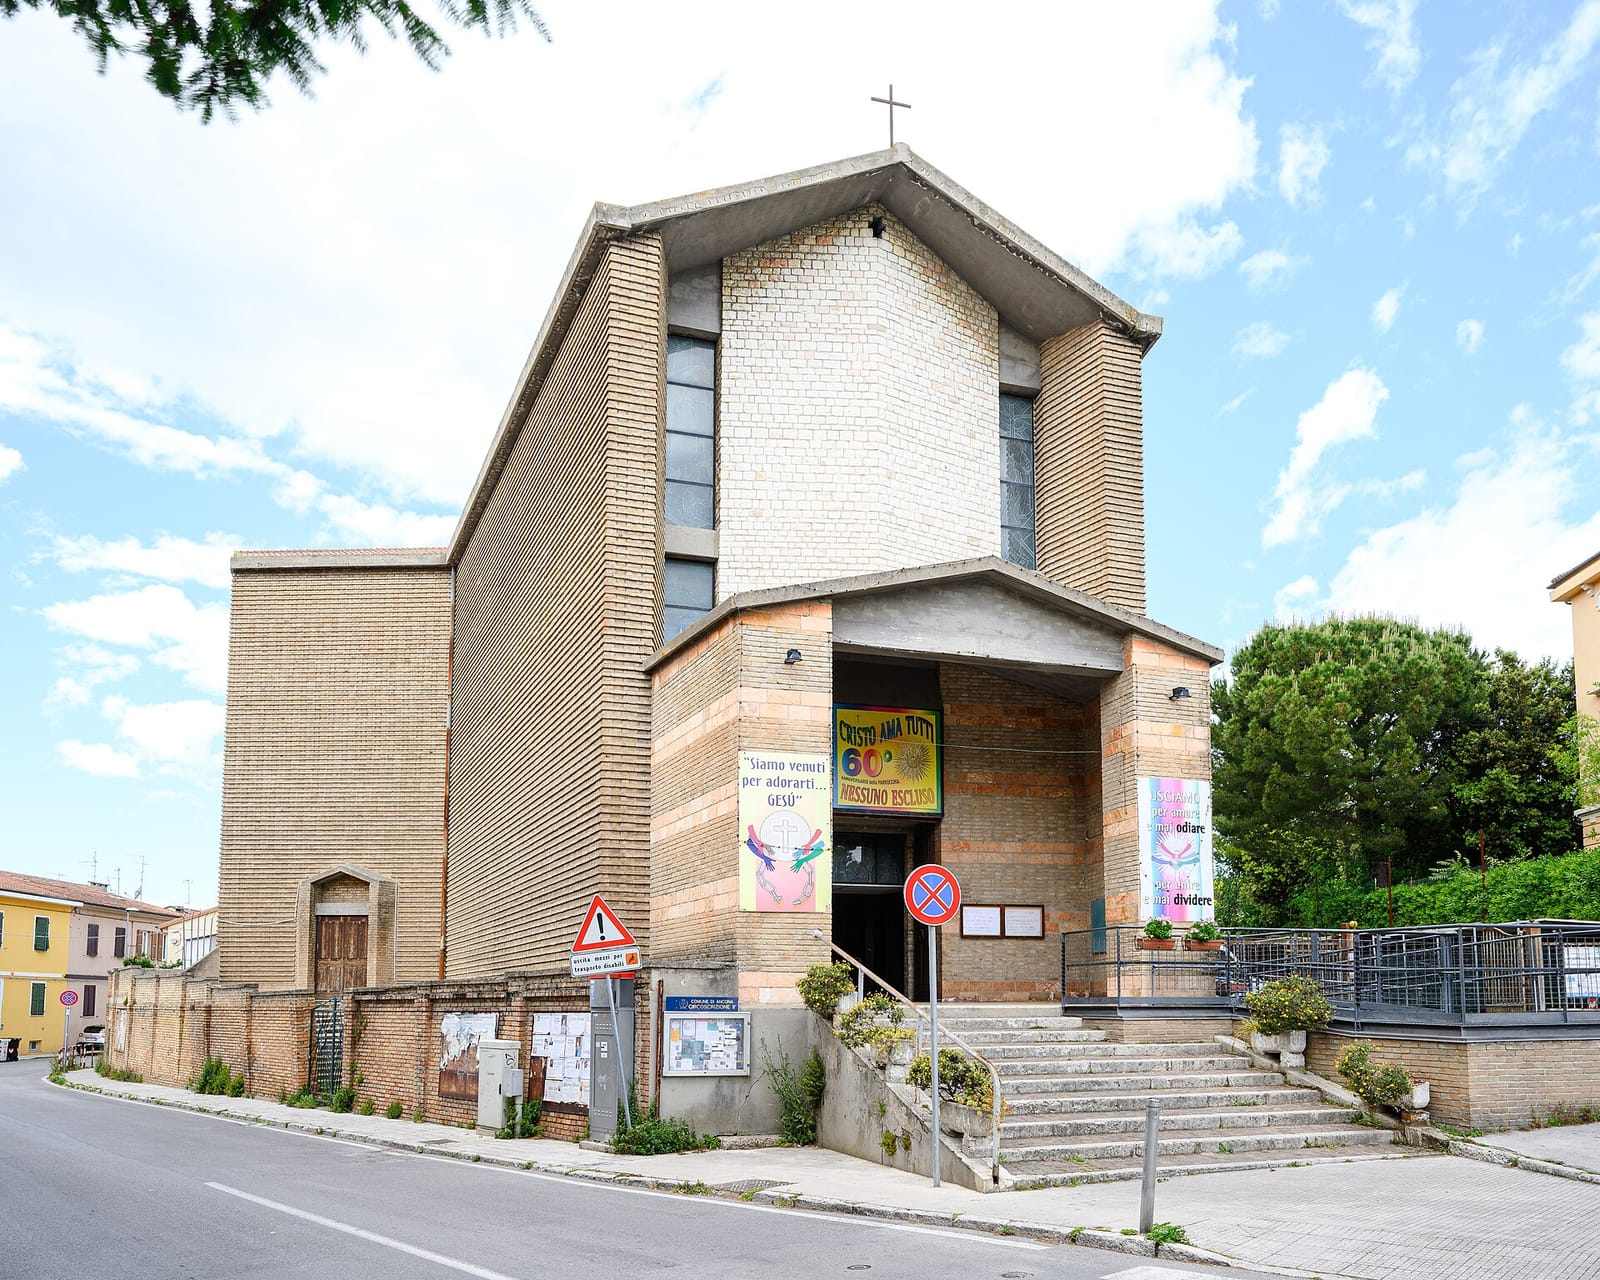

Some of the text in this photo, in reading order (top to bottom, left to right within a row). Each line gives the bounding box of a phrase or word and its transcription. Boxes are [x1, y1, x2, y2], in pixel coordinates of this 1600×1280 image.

[839, 715, 934, 747] CRISTO AMA TUTTI
[789, 761, 826, 773] venuti
[742, 775, 827, 790] per adorarti...
[840, 783, 935, 806] NESSUNO ESCLUSO
[1152, 807, 1167, 819] per
[1171, 808, 1200, 819] amare
[1155, 822, 1173, 833] mai
[1176, 822, 1206, 834] odiare
[1154, 880, 1172, 891] per
[1153, 895, 1171, 905] mai
[1174, 893, 1213, 906] dividere
[574, 961, 625, 972] trasporto disabili
